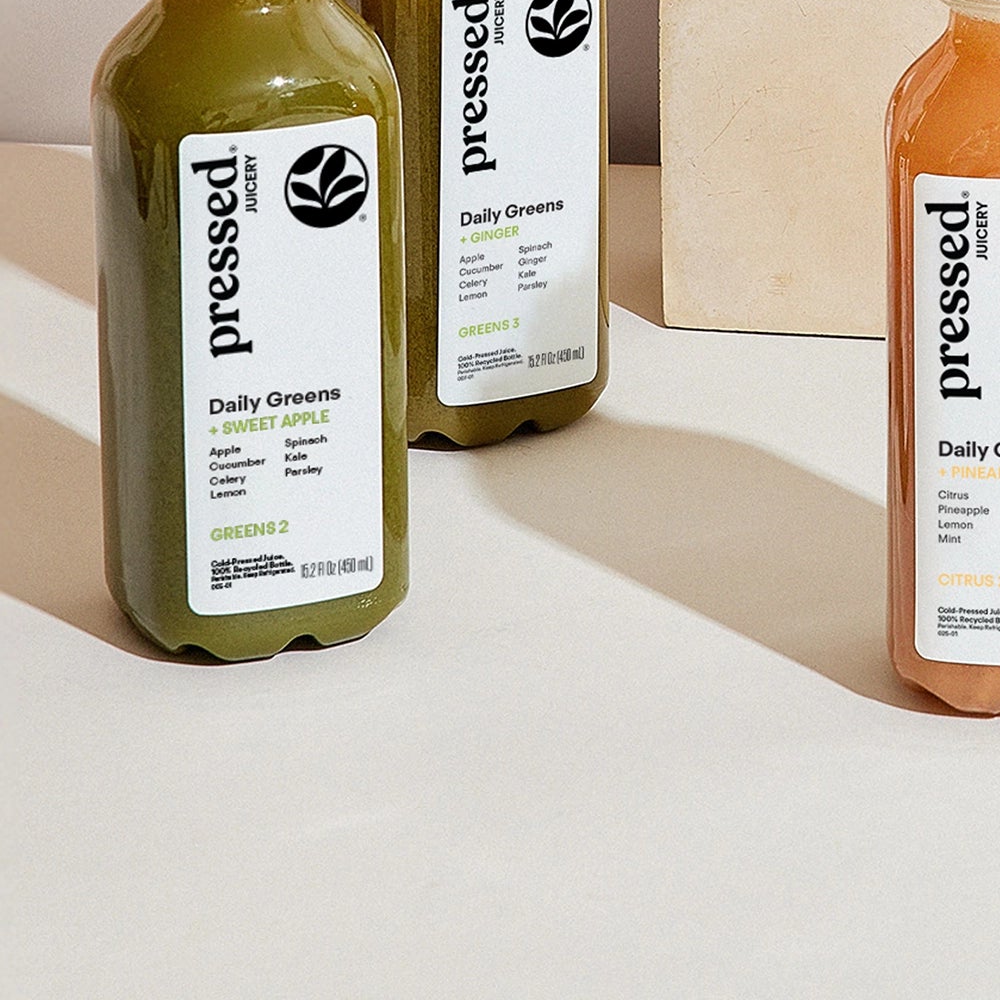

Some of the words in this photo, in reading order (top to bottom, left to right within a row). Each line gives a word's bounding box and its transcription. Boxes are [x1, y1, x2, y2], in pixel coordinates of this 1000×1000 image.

[245, 154, 257, 213] JUICERY
[460, 208, 501, 226] Daily
[505, 200, 564, 218] Greens
[470, 226, 519, 243] GINGER
[976, 201, 988, 260] JUICERY
[518, 242, 552, 254] Spinach
[191, 156, 252, 358] pressed
[460, 253, 485, 264] Apple
[518, 256, 547, 266] Ginger
[460, 263, 503, 276] Cucumber
[518, 270, 536, 279] Kale
[459, 278, 488, 289] Celery
[518, 281, 548, 292] Parsley
[459, 291, 487, 301] Lemon
[925, 201, 982, 400] pressed
[458, 320, 510, 338] GREENS
[513, 318, 520, 328] 3
[209, 395, 261, 415] Daily
[266, 388, 341, 407] Greens
[222, 415, 277, 434] SWEET
[281, 409, 330, 428] APPLE
[285, 435, 327, 449] Spinach
[209, 445, 241, 458] Apple
[285, 452, 307, 462] Kale
[939, 441, 989, 461] Daily
[209, 458, 266, 471] Cucumber
[285, 466, 323, 477] Parsley
[209, 475, 246, 486] Celery
[211, 489, 246, 499] Lemon
[938, 490, 969, 500] Citrus
[938, 505, 989, 516] Pineapple
[210, 522, 276, 542] GREENS
[279, 520, 289, 533] 2
[938, 520, 973, 529] Lemon
[938, 535, 961, 543] Mint
[938, 573, 994, 587] CITRUS
